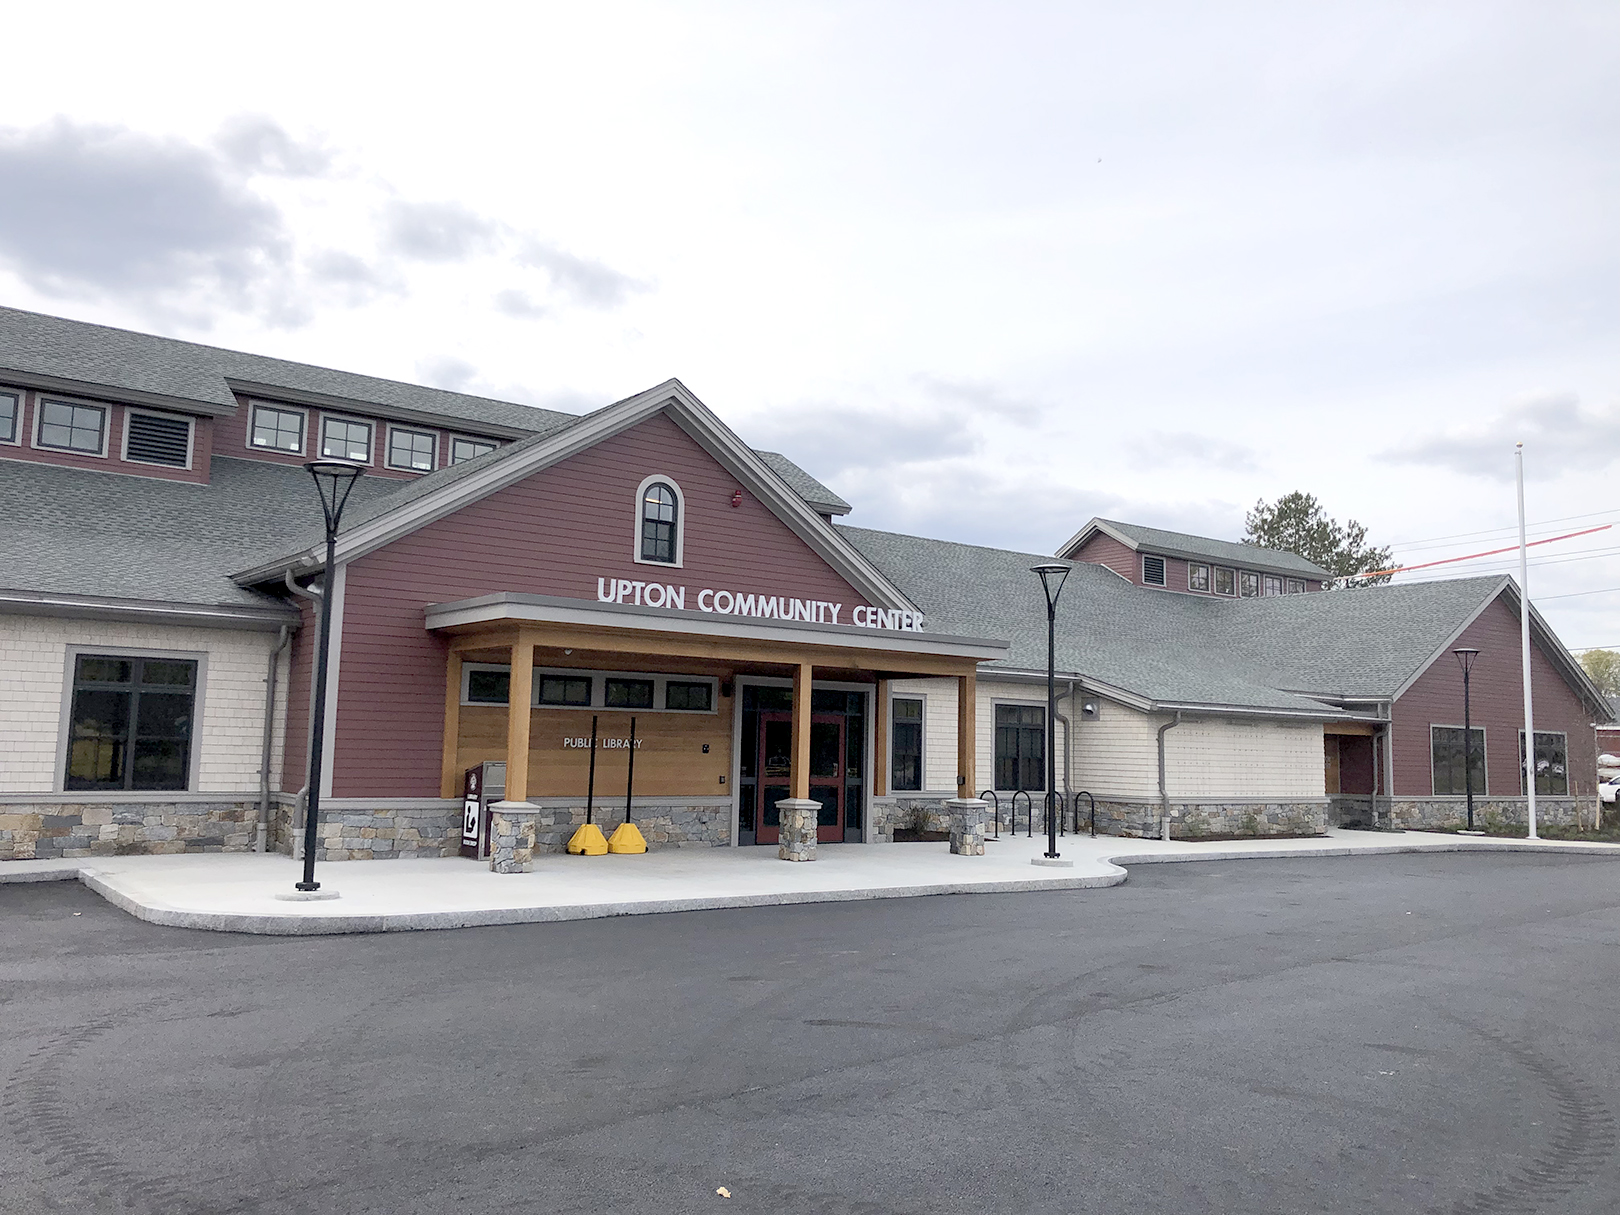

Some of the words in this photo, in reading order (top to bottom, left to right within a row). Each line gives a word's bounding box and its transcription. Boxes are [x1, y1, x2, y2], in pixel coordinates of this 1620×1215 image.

[597, 577, 685, 610] UPTON
[698, 588, 842, 625] COMMUNITY
[852, 605, 924, 633] CENTER
